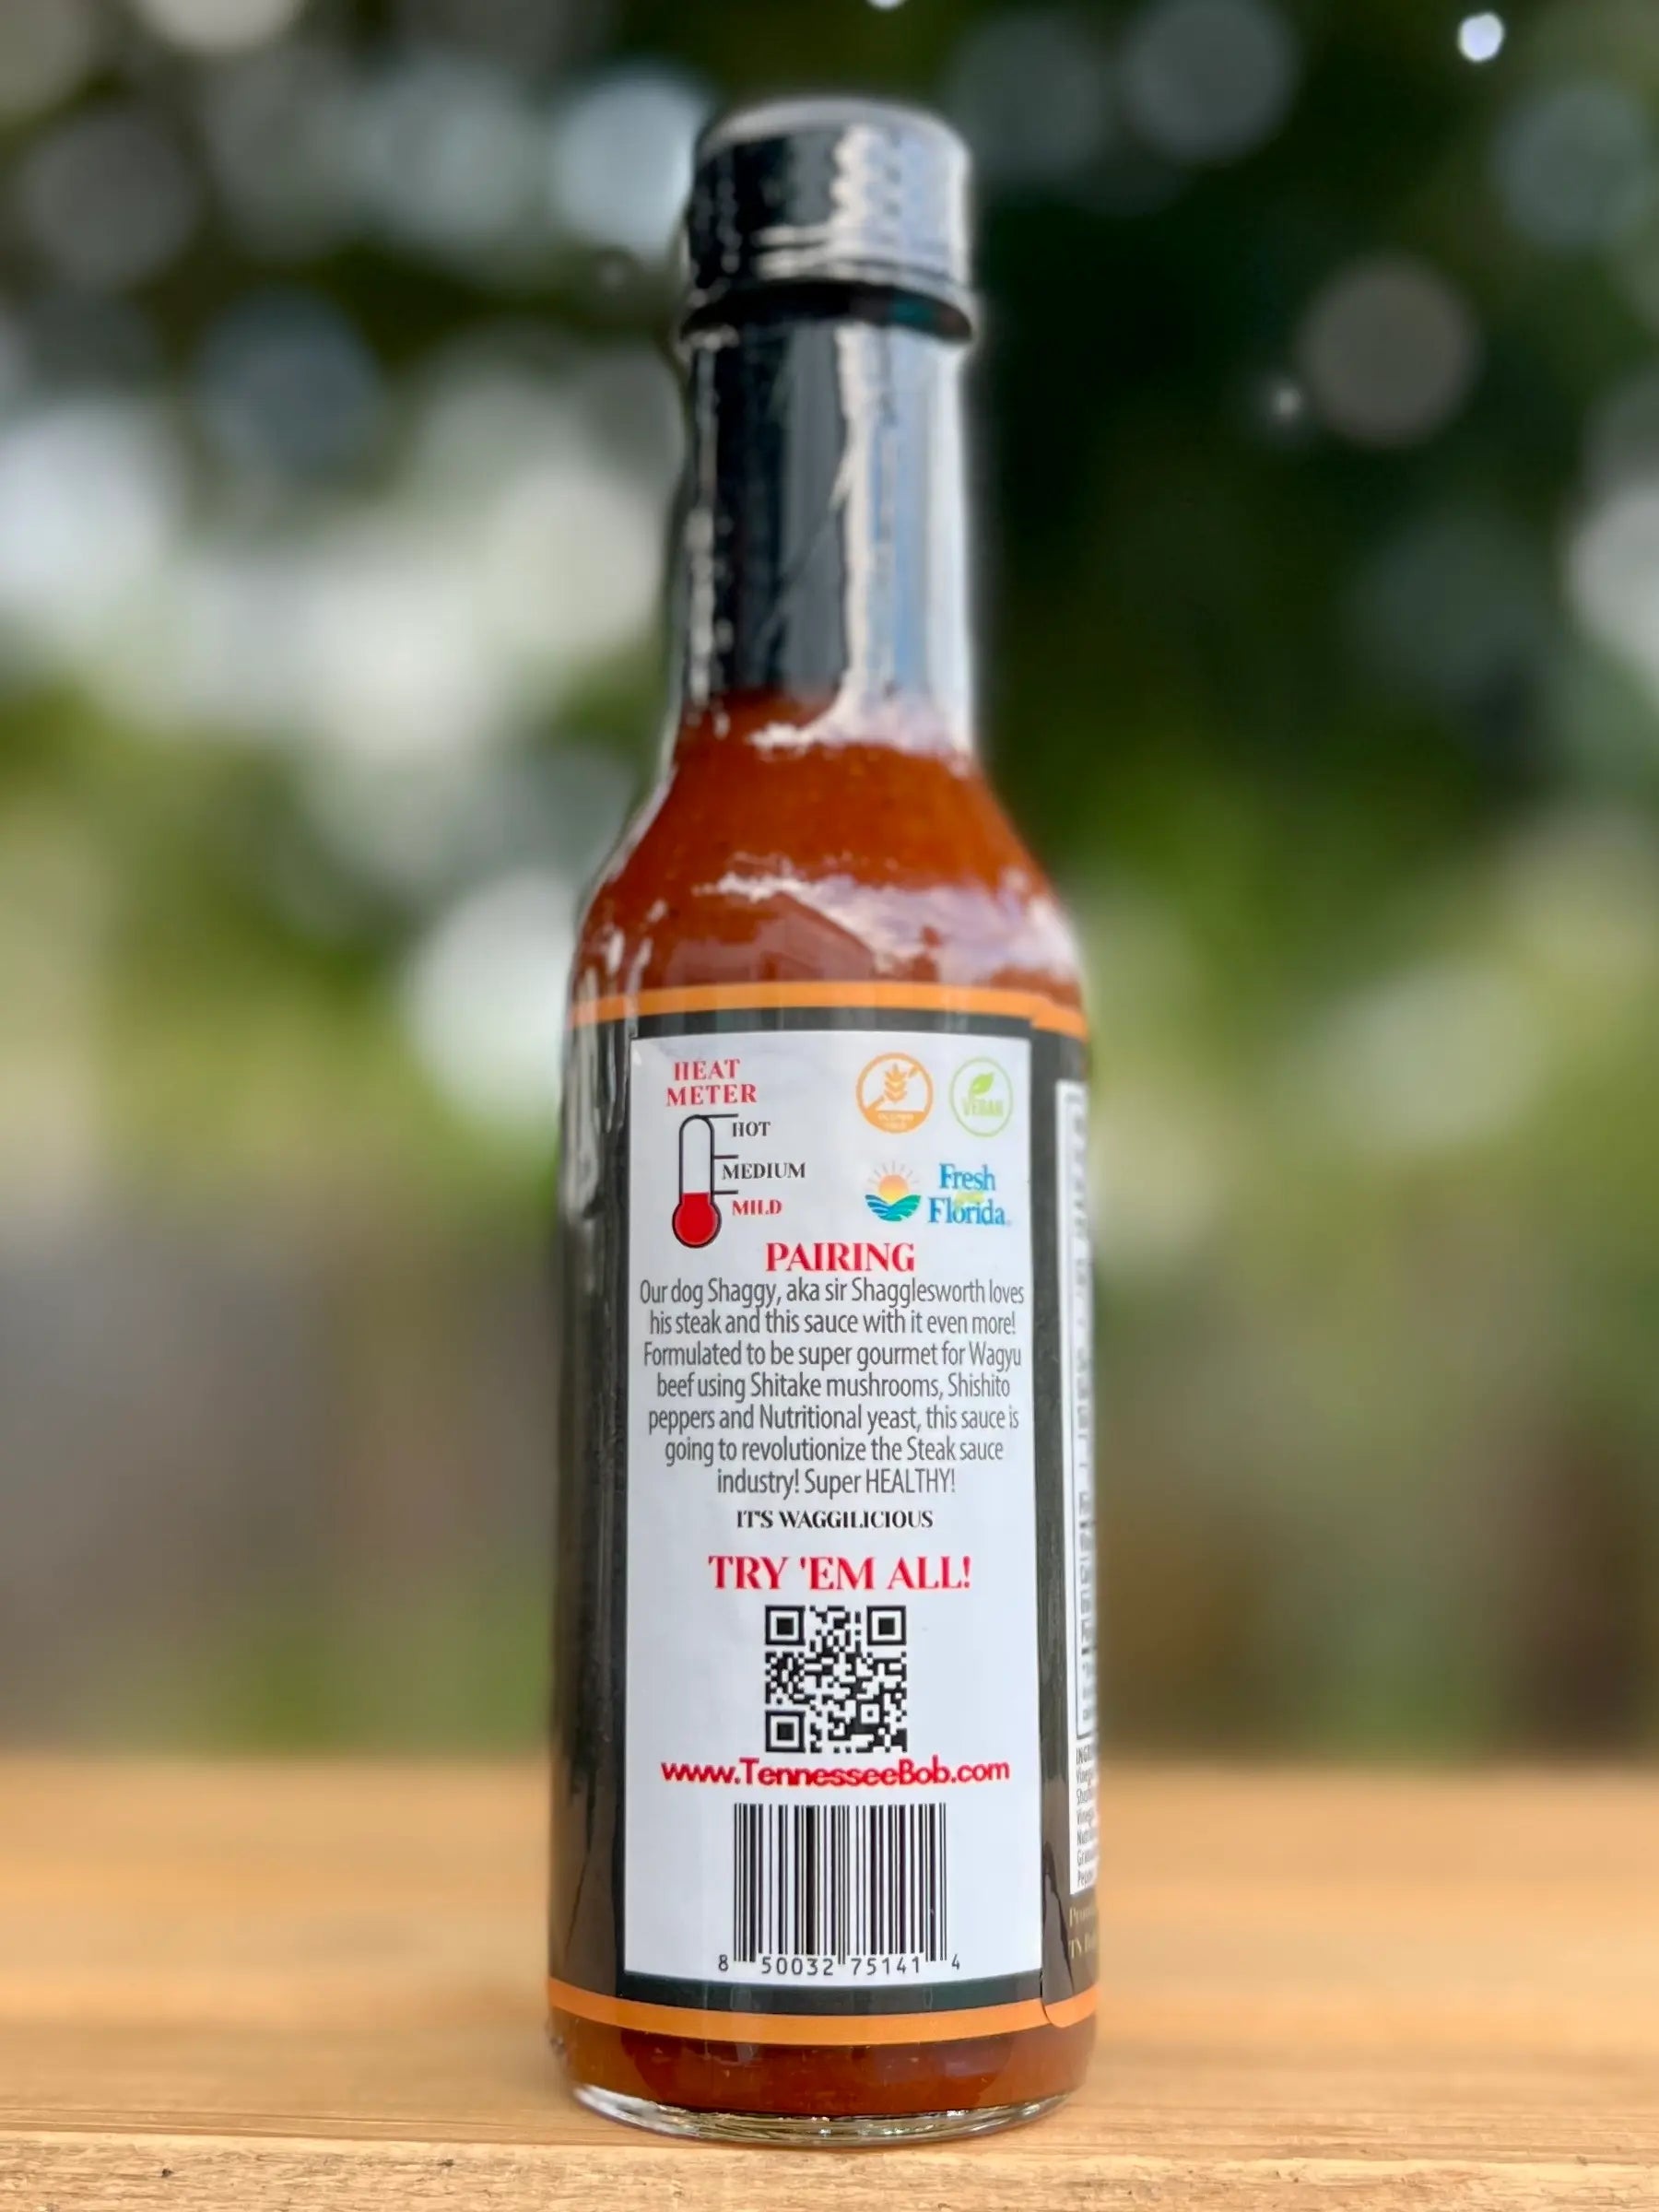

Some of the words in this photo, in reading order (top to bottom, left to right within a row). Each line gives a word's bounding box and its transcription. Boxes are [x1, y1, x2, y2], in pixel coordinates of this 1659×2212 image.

[675, 1059, 740, 1081] HEAT
[667, 1084, 757, 1106] METER
[732, 1121, 771, 1137] HOT
[722, 1162, 806, 1180] MEDIUM
[938, 1163, 995, 1191] Fresh
[733, 1199, 782, 1216] MILD
[928, 1196, 1005, 1225] Florida
[766, 1242, 914, 1273] PAIRING
[641, 1279, 668, 1304] Our
[671, 1278, 703, 1310] dog
[708, 1277, 782, 1311] Shaggy,
[786, 1277, 820, 1301] aka
[825, 1277, 848, 1301] sir
[852, 1277, 985, 1310] Shagglesworth
[989, 1278, 1024, 1304] loves
[651, 1310, 672, 1335] his
[676, 1309, 722, 1335] steak
[724, 1307, 762, 1334] and
[764, 1308, 800, 1334] this
[804, 1314, 859, 1333] sauce
[863, 1307, 906, 1334] with
[911, 1310, 923, 1333] it
[926, 1315, 968, 1335] even
[972, 1311, 1016, 1335] more!
[644, 1340, 742, 1366] Formulated
[746, 1343, 766, 1365] to
[771, 1340, 794, 1365] be
[798, 1347, 852, 1371] super
[857, 1343, 938, 1372] gourmet
[941, 1340, 966, 1366] for
[969, 1340, 1021, 1372] Wagyu
[657, 1371, 695, 1397] beef
[698, 1372, 746, 1404] using
[750, 1371, 821, 1397] Shitake
[827, 1374, 943, 1400] mushrooms,
[947, 1371, 1010, 1397] Shishito
[649, 1410, 715, 1436] peppers
[719, 1404, 754, 1430] and
[759, 1404, 862, 1430] Nutritional
[866, 1406, 922, 1436] yeast,
[925, 1404, 958, 1429] this
[961, 1410, 1006, 1429] sauce
[1009, 1406, 1018, 1429] is
[665, 1436, 713, 1467] going
[718, 1438, 737, 1461] to
[742, 1435, 866, 1462] revolutionize
[870, 1435, 902, 1461] the
[907, 1435, 956, 1461] Steak
[959, 1442, 1004, 1460] sauce
[717, 1467, 799, 1500] industry!
[805, 1468, 862, 1500] Super
[866, 1467, 955, 1493] HEALTHY!
[737, 1510, 773, 1529] IT'S
[778, 1509, 933, 1530] WAGGILICIOUS
[708, 1556, 789, 1590] TRY
[799, 1557, 875, 1591] 'EM
[887, 1556, 971, 1590] ALL!
[661, 1754, 1010, 1788] www.TennesseeBob.com
[718, 1954, 728, 1971] 8
[761, 1958, 833, 1976] 50032
[852, 1958, 921, 1974] 75141
[951, 1953, 960, 1971] 4
